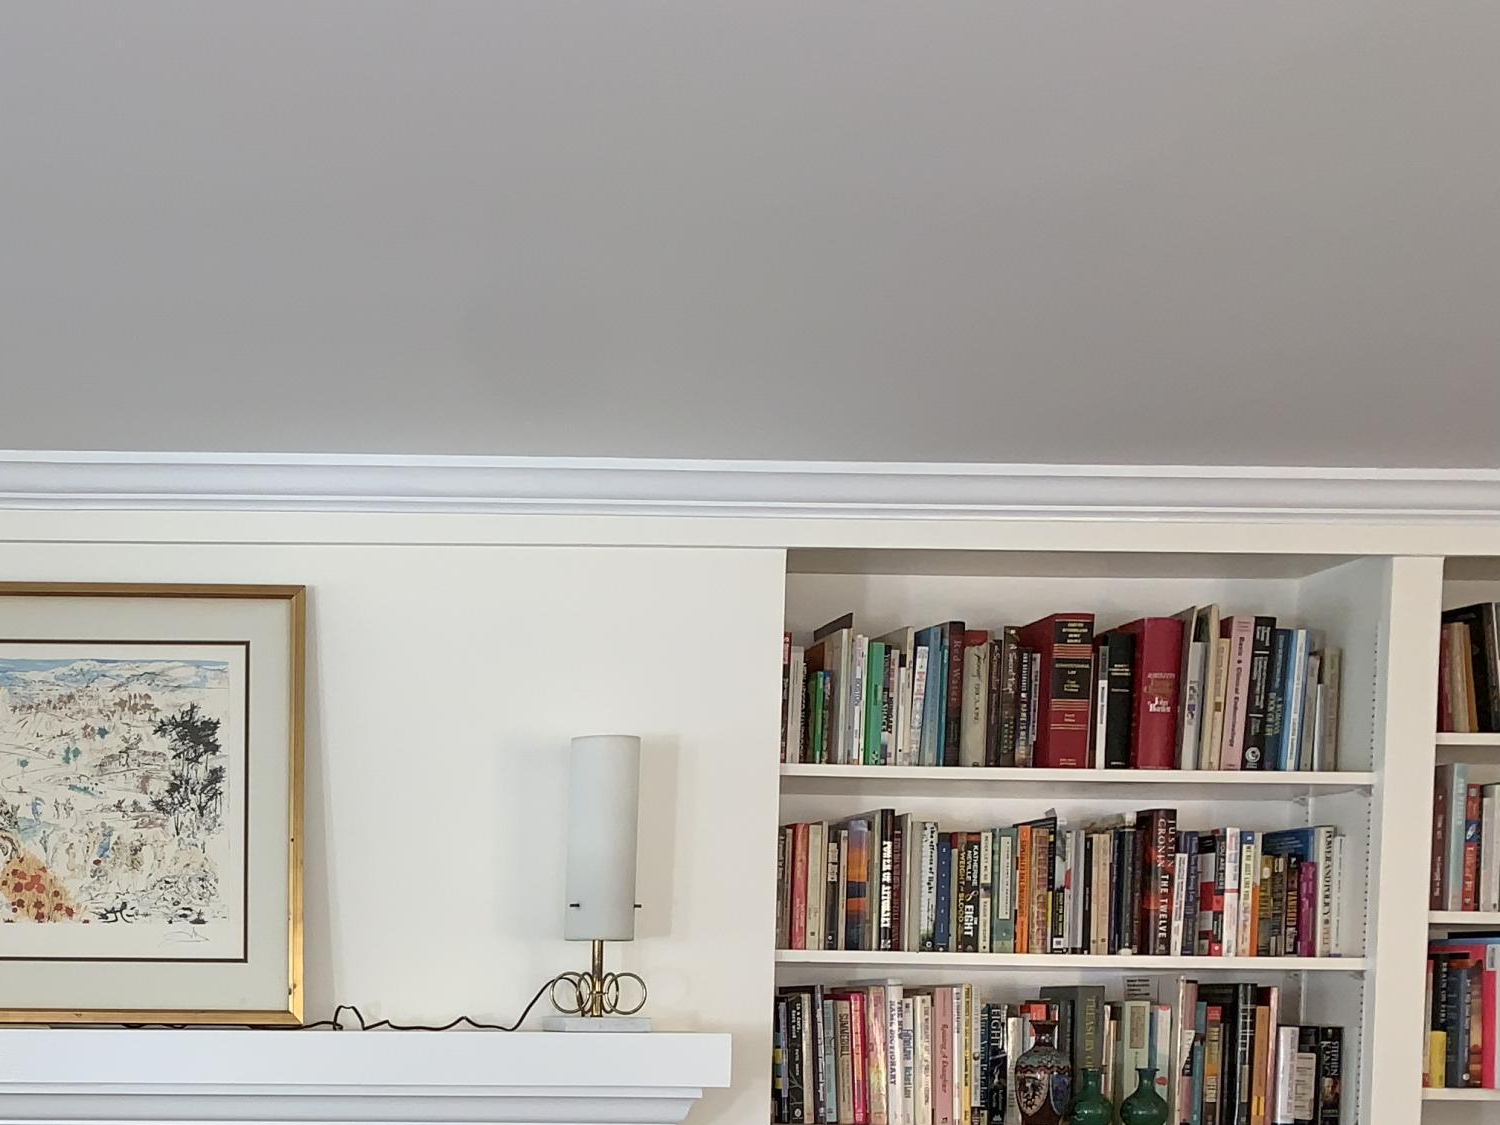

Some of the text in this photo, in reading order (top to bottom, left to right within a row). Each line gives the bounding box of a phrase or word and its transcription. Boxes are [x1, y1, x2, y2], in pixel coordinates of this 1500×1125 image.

[951, 640, 961, 702] Red Water
[1157, 818, 1166, 868] CRONIN
[1167, 820, 1176, 868] JUSTIN
[964, 905, 974, 937] EIGHT
[1159, 875, 1169, 938] THE TWELVE
[991, 1009, 1001, 1049] EIGHT
[1331, 1041, 1339, 1076] STEPHEN
